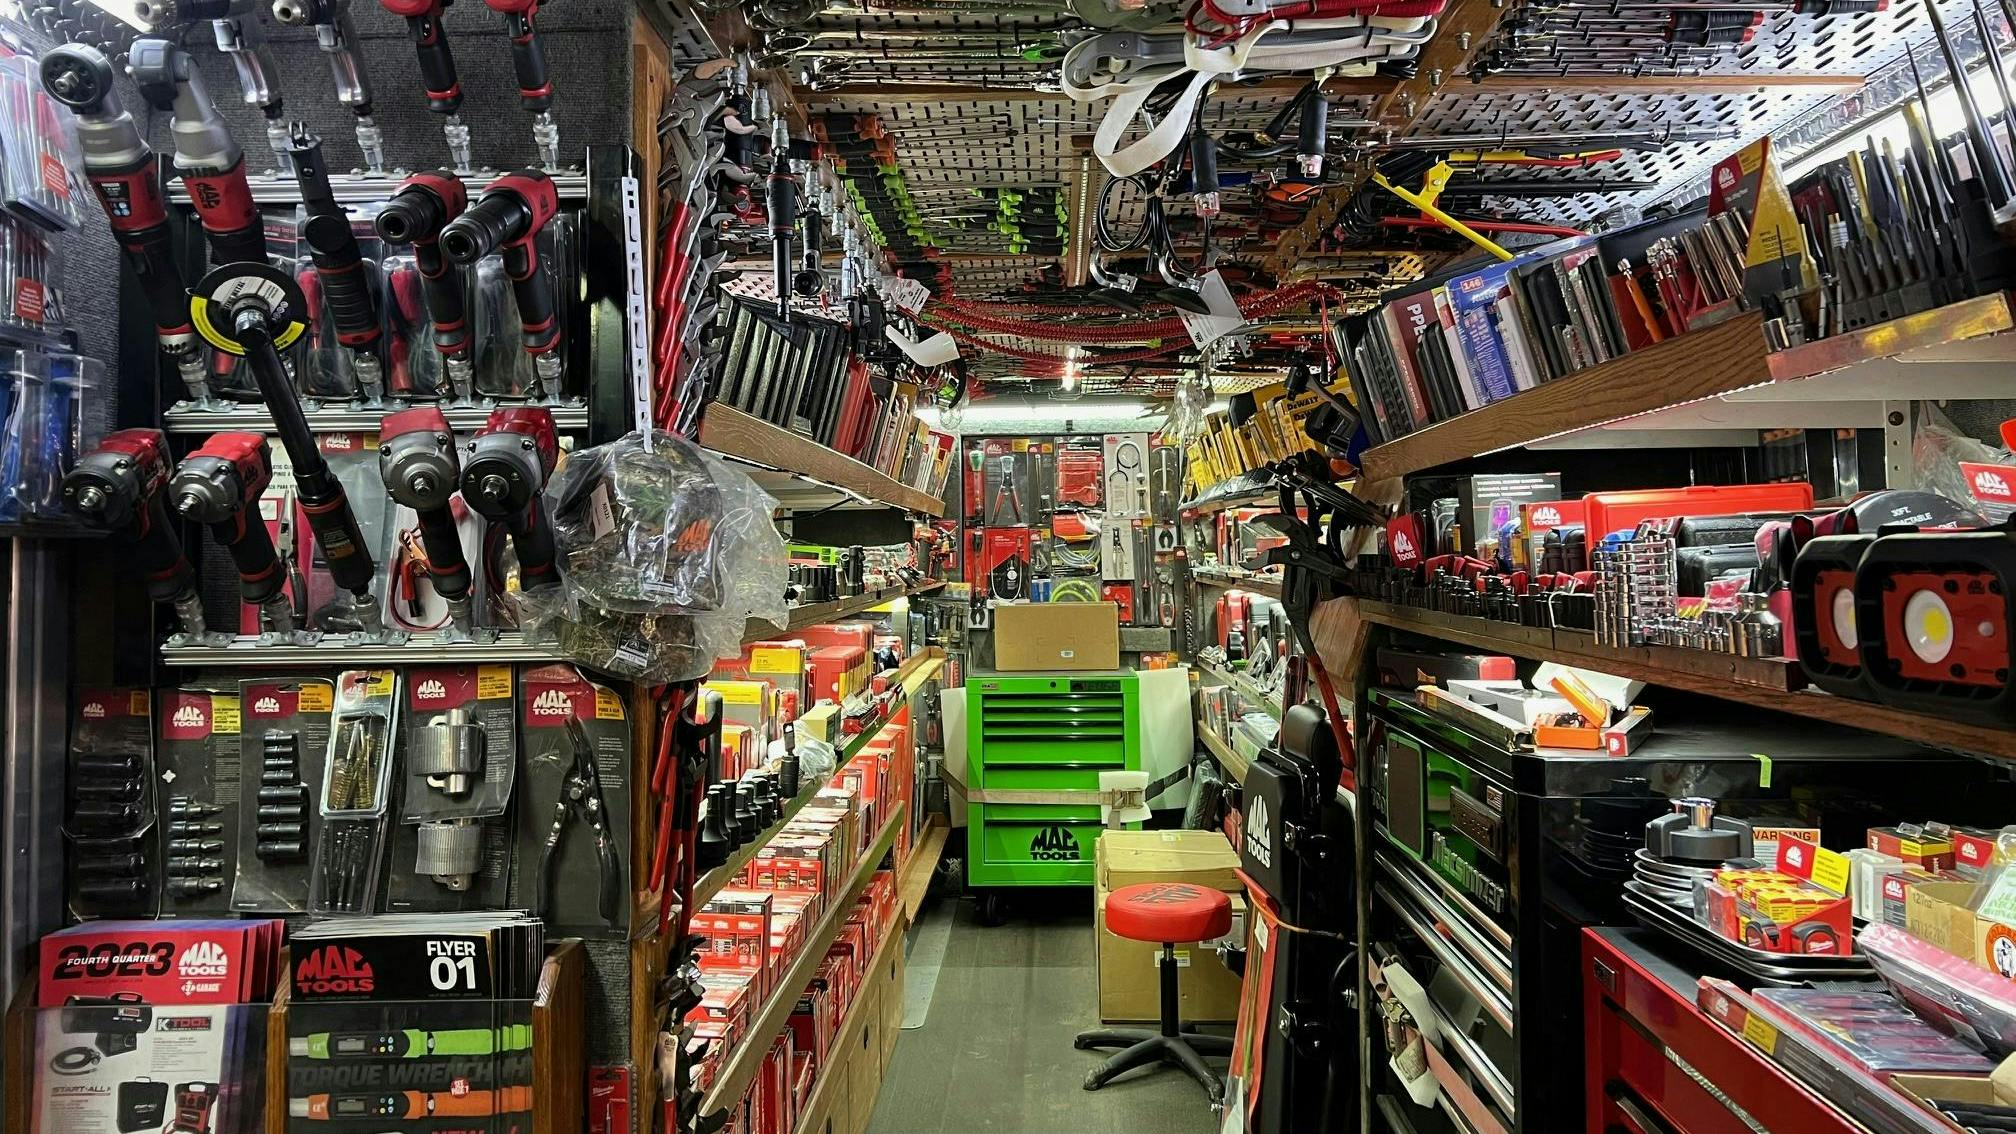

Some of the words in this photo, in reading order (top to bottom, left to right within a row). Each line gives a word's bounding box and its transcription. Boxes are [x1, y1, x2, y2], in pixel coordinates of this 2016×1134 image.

[1975, 471, 2009, 489] MAC
[1978, 486, 2011, 496] TOOLS
[1532, 506, 1560, 521] MAC
[1394, 530, 1414, 553] MAC
[1396, 550, 1417, 562] TOOLS
[416, 679, 445, 693] MAC
[255, 696, 280, 709] MAC
[417, 691, 446, 699] TOOLS
[532, 689, 572, 709] MAC
[83, 702, 105, 713] MAC
[172, 706, 205, 722] MAC
[532, 708, 573, 716] TOOLS
[1030, 824, 1079, 851] MAC
[1752, 830, 1811, 841] WARNG
[1030, 850, 1080, 861] TOOLS
[1247, 835, 1271, 869] TOOLS
[178, 941, 228, 967] MAC
[426, 940, 476, 956] FLYER
[52, 941, 176, 981] 2023
[66, 956, 108, 966] FOURTH
[112, 953, 158, 964] QUARTER
[296, 945, 374, 980] MAC
[178, 965, 228, 976] TOOLS
[430, 956, 476, 990] 01
[296, 979, 375, 993] TOOLS
[290, 1063, 384, 1086] TORQUE
[387, 1061, 493, 1085] WRENCH
